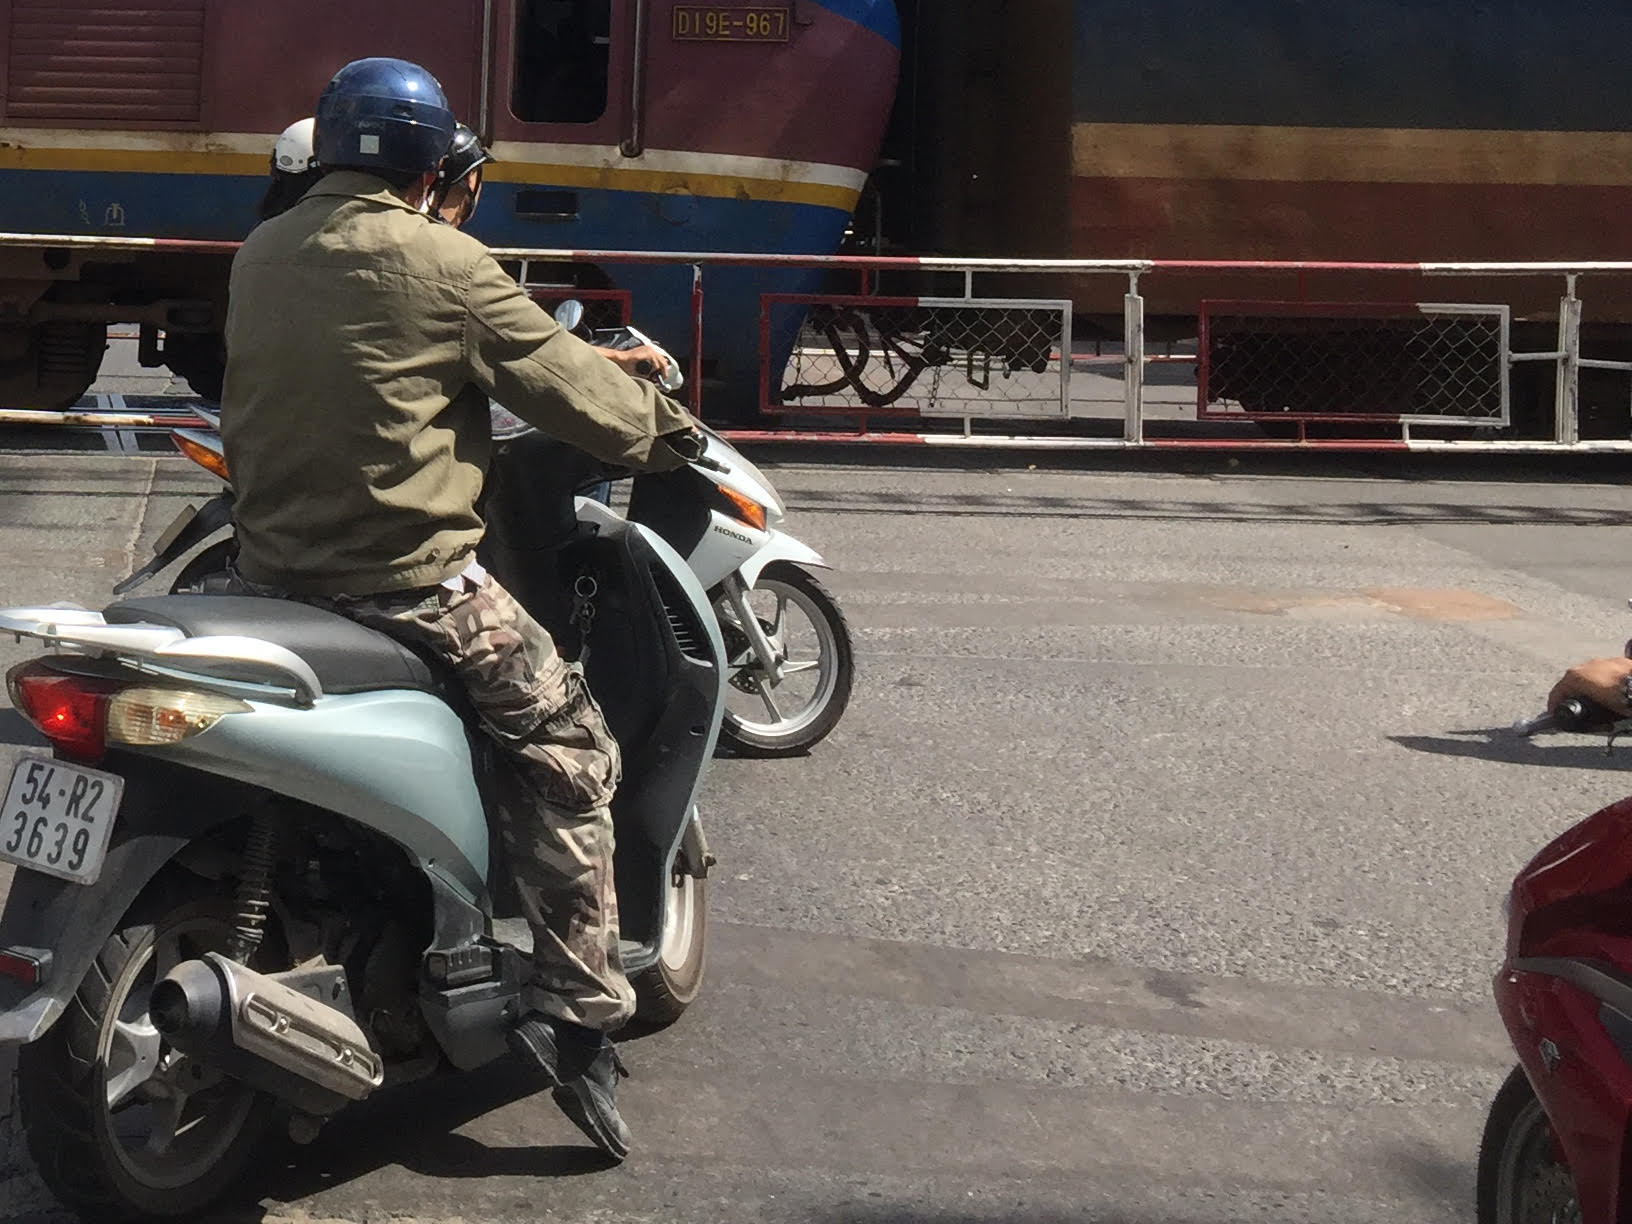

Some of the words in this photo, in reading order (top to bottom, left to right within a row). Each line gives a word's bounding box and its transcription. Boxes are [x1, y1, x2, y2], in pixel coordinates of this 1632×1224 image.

[678, 11, 787, 37] D19E-967
[713, 525, 754, 546] HONDA
[5, 809, 91, 871] 3639
